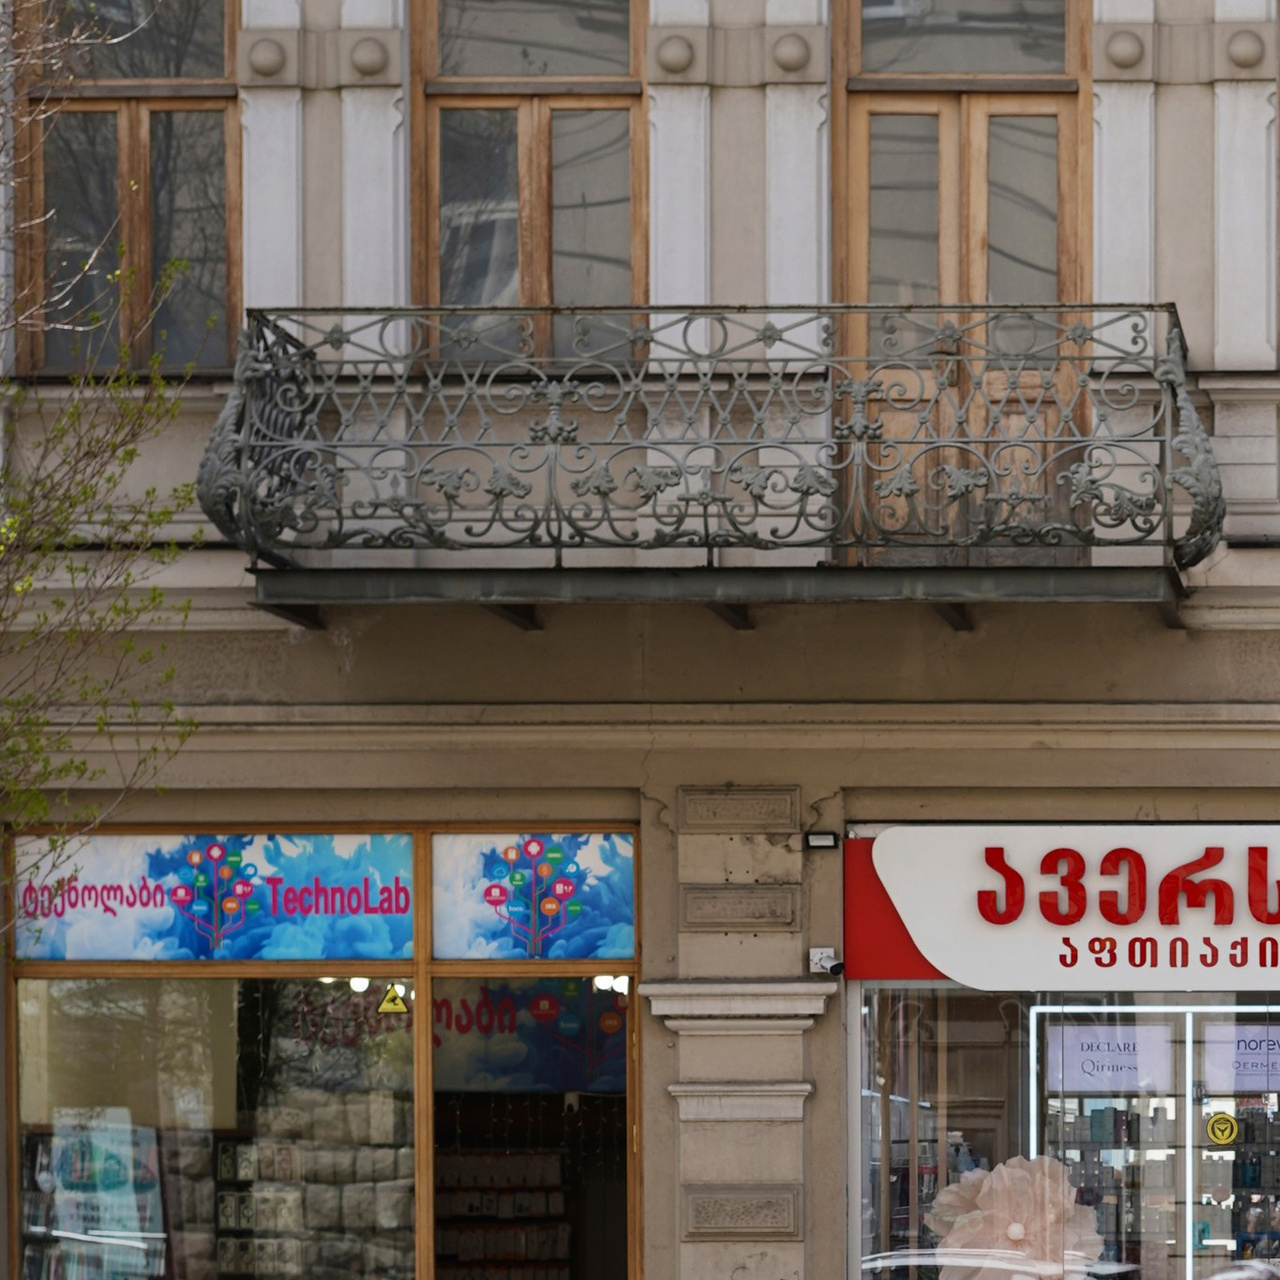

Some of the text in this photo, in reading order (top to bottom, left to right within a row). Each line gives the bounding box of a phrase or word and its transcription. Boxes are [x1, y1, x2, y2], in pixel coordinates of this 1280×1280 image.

[22, 876, 165, 918] ტექნოლაბი
[265, 875, 410, 915] TechnoLab
[1059, 937, 1279, 968] აფთიაქი
[1080, 1041, 1139, 1053] DECLARE
[1080, 1058, 1138, 1077] Qiriness
